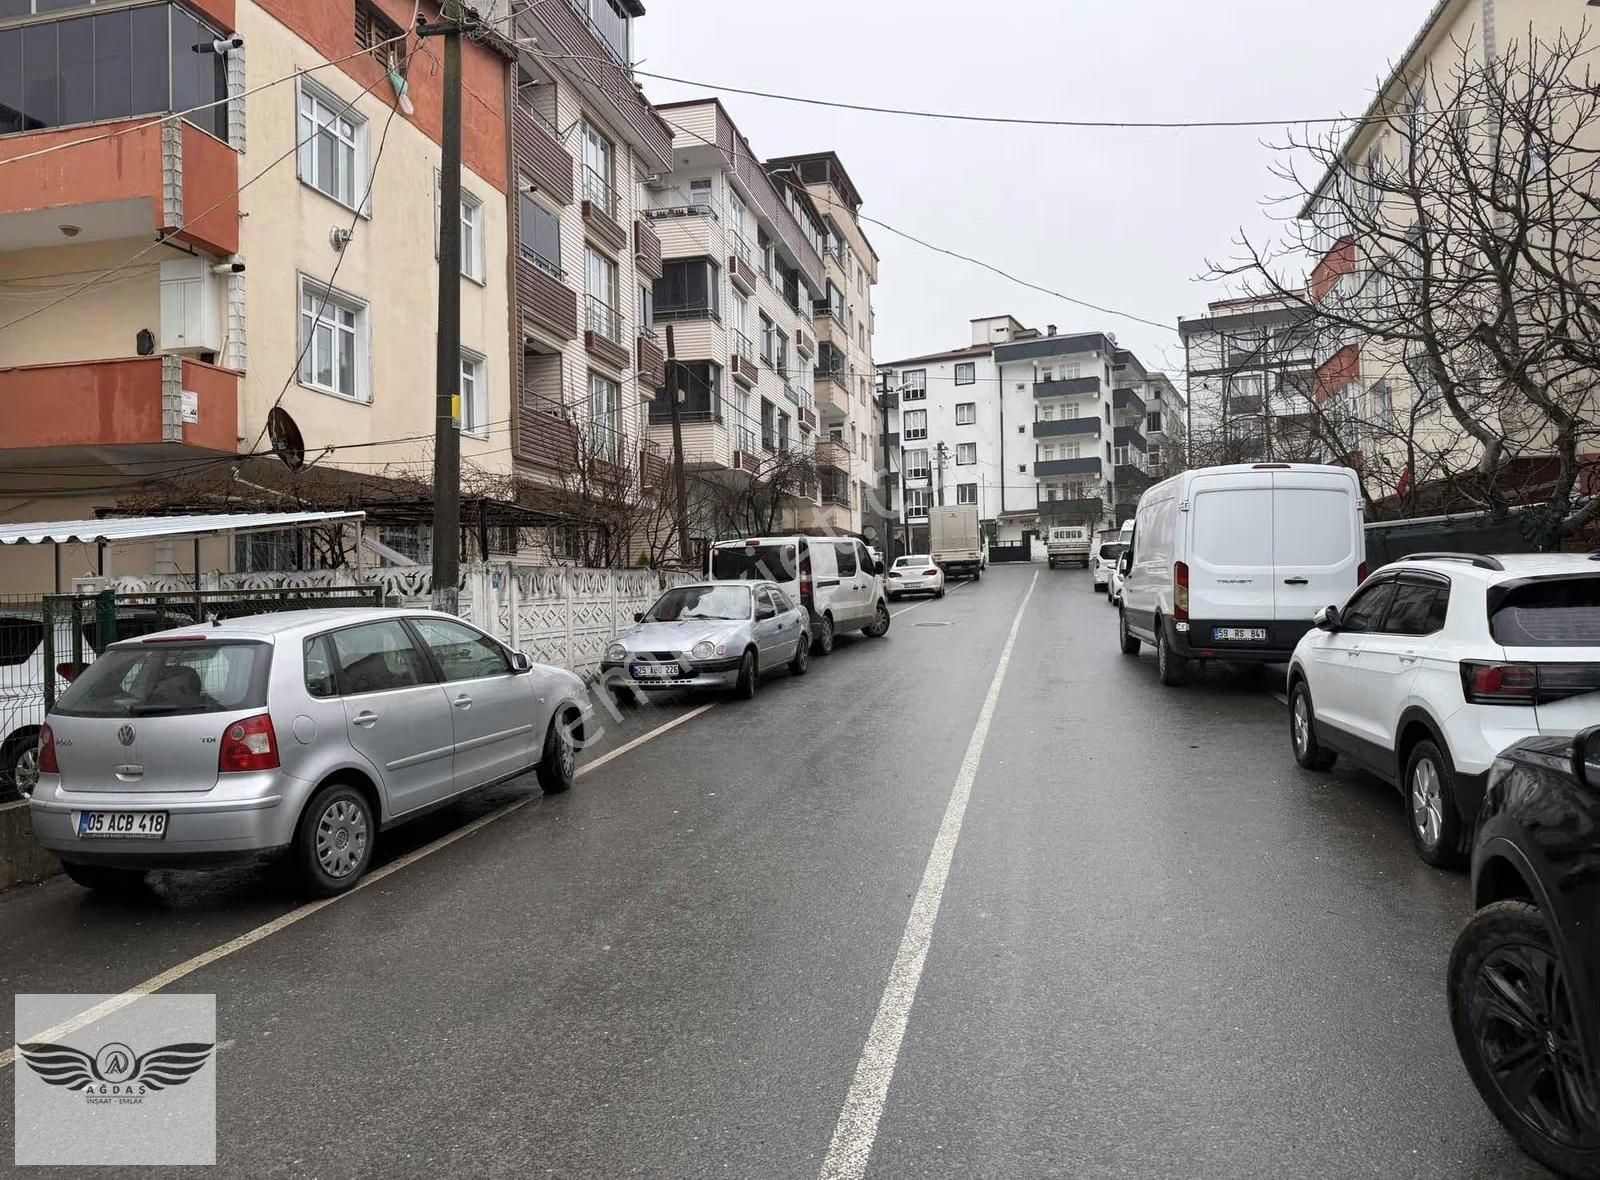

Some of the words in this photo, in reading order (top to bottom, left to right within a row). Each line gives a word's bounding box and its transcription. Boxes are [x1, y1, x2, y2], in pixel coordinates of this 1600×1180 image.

[1219, 629, 1229, 637] 59
[1234, 629, 1245, 638] RS
[1250, 629, 1265, 638] 841
[638, 666, 646, 675] 25
[665, 665, 679, 674] 226
[87, 814, 104, 831] 05
[107, 814, 135, 832] ACB
[138, 814, 164, 833] 418
